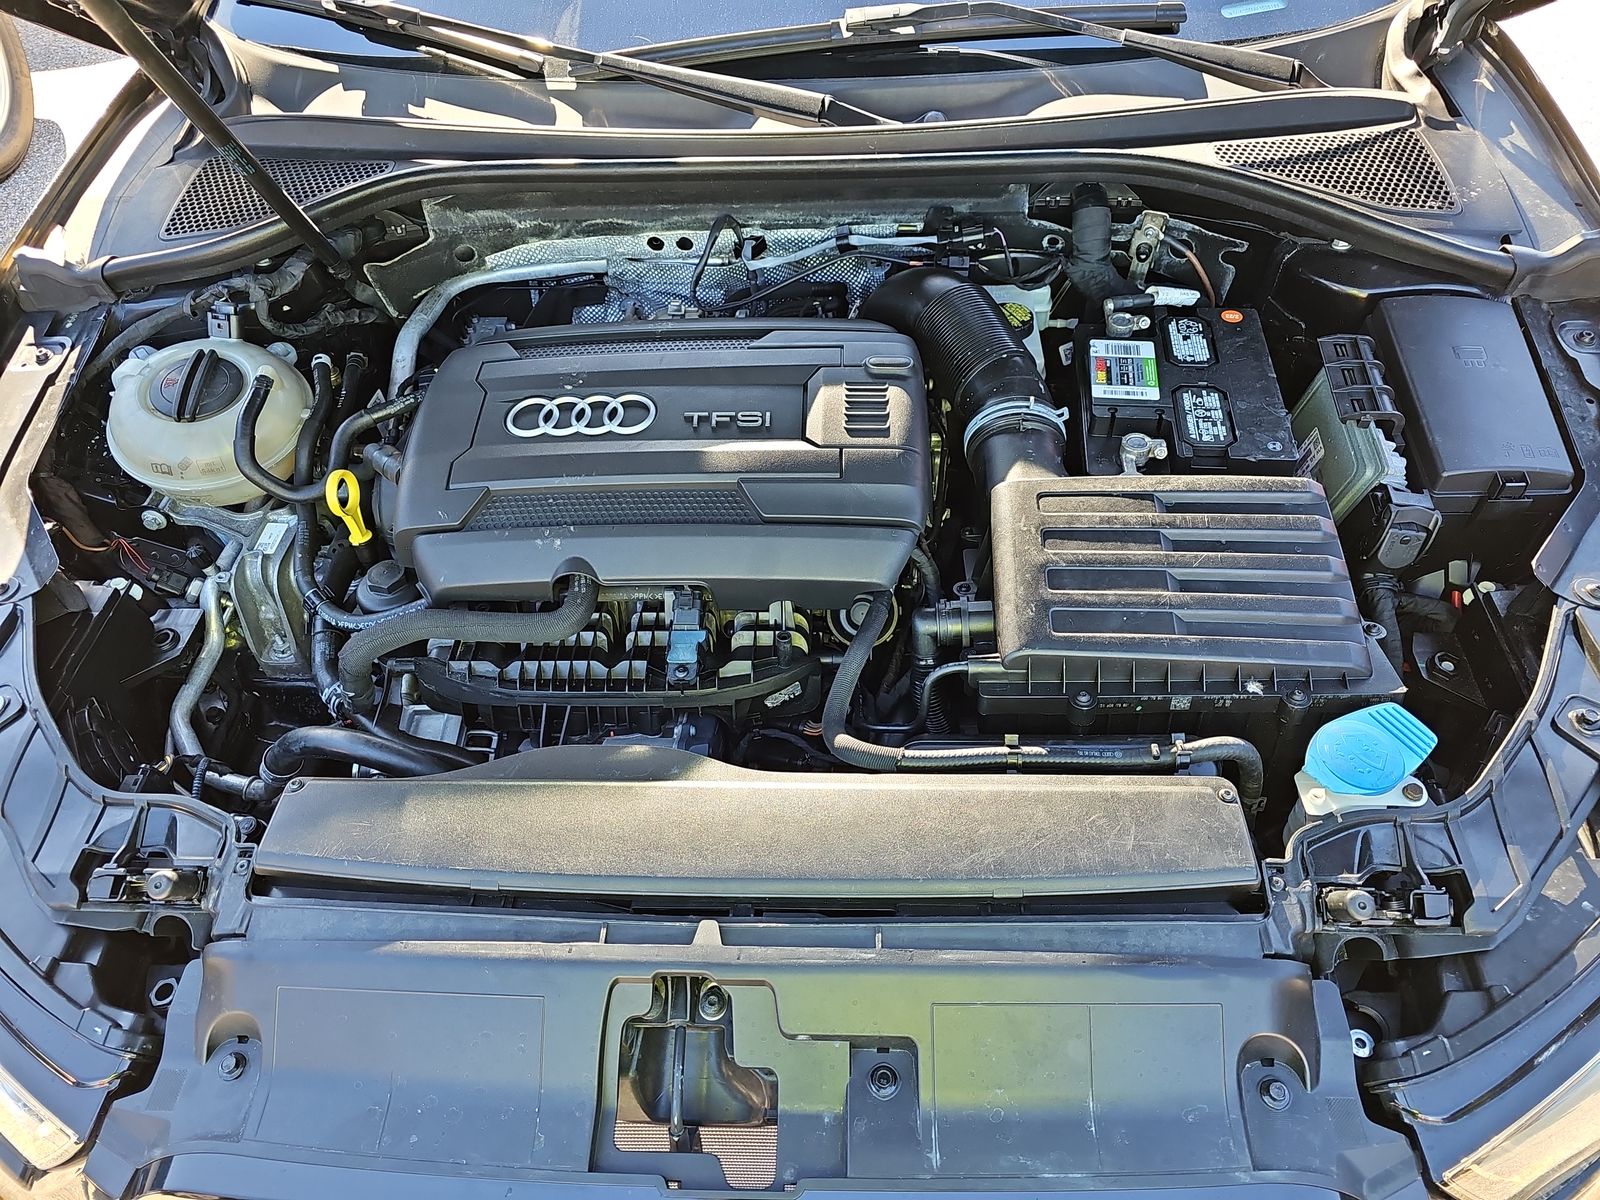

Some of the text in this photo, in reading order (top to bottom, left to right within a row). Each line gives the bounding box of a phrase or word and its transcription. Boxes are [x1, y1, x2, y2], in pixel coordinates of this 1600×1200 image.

[1182, 392, 1192, 411] POISON
[683, 411, 772, 428] TFSI
[1186, 414, 1196, 434] DANGER
